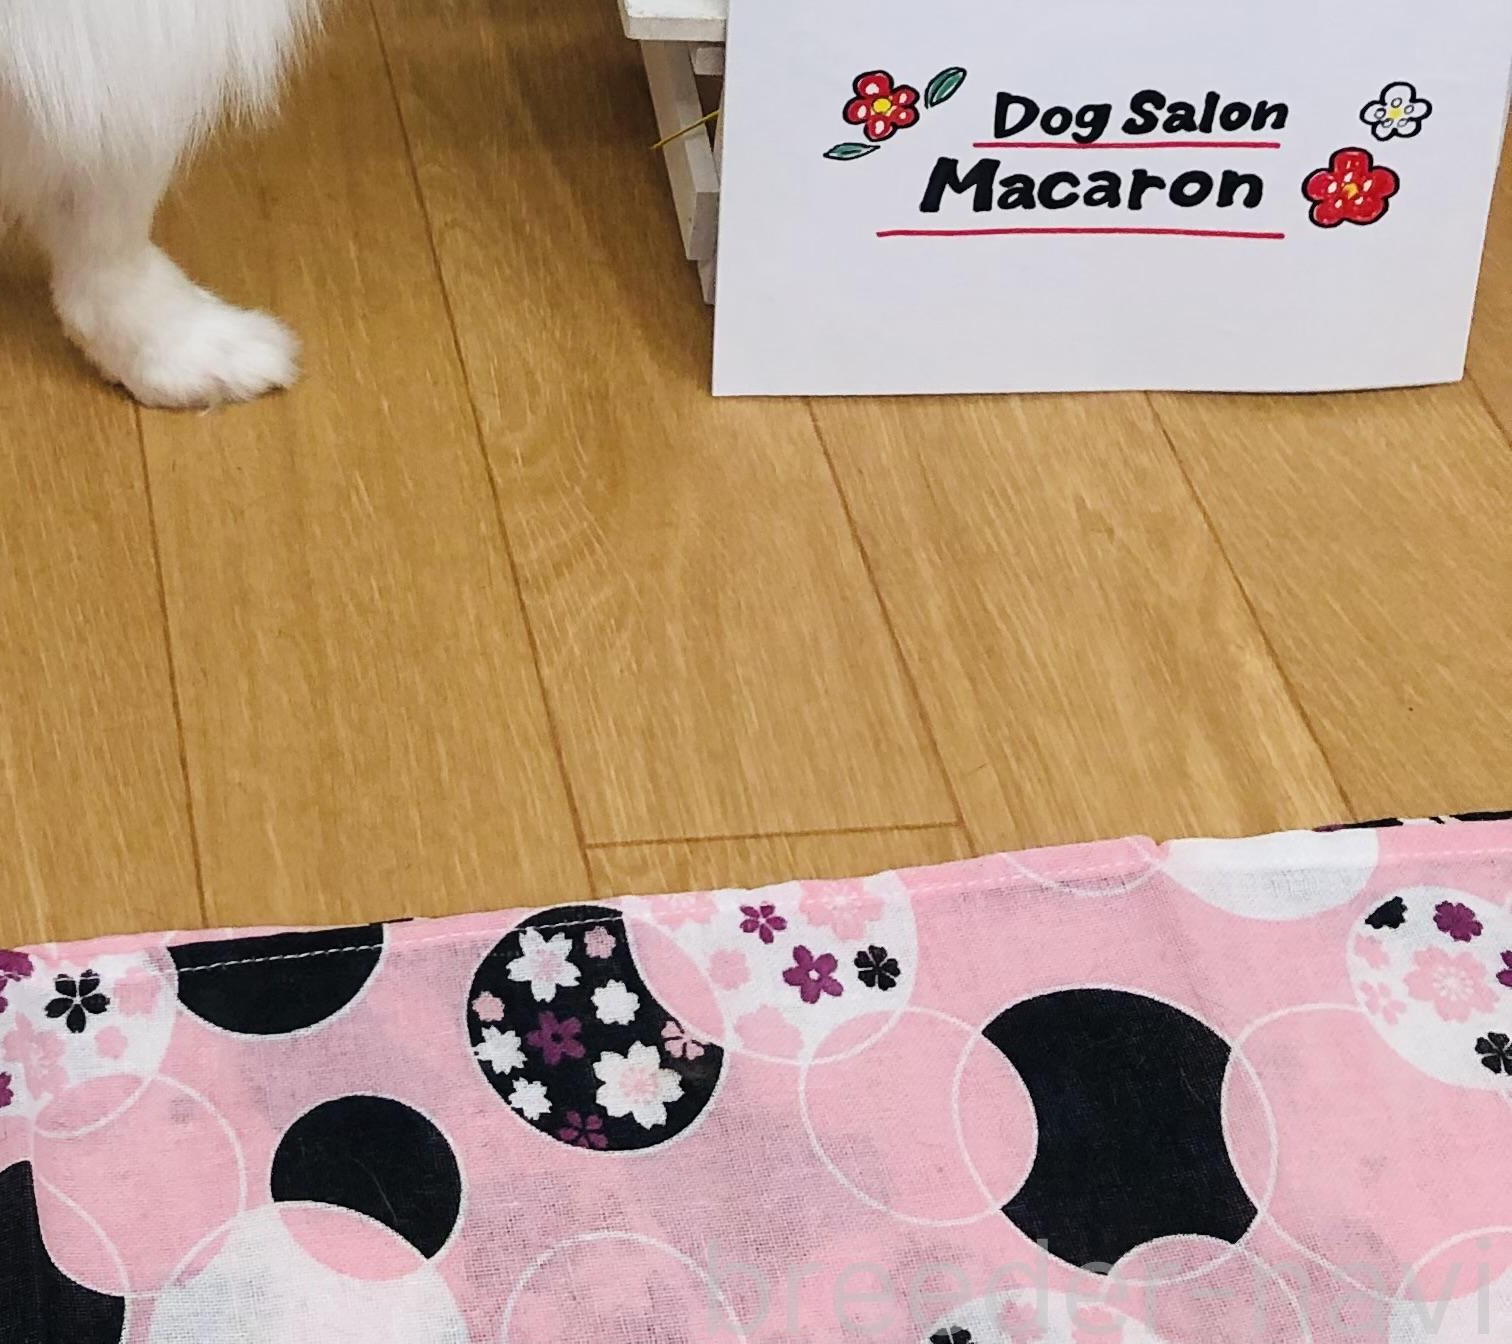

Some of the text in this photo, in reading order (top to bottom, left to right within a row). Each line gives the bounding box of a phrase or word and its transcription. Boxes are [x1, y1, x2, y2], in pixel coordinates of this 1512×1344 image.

[993, 89, 1289, 145] Dog Salon
[919, 157, 1264, 213] Macaron
